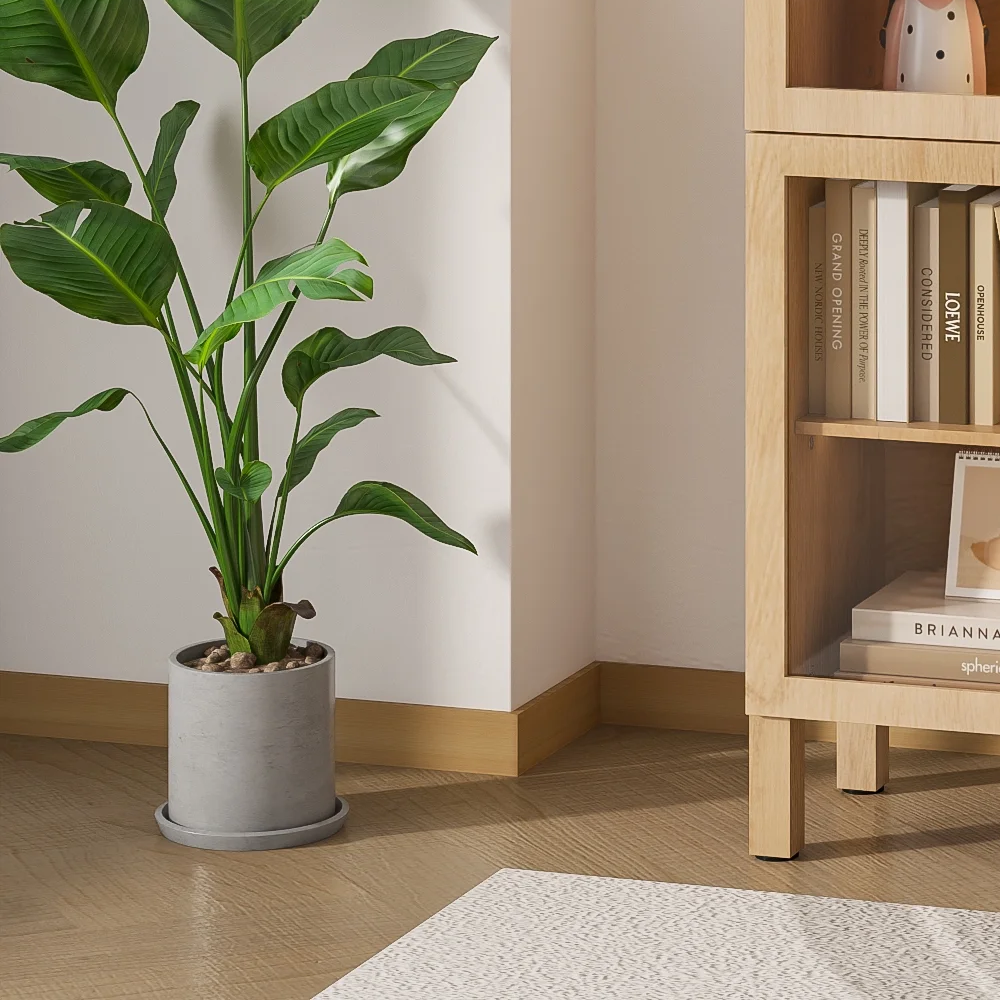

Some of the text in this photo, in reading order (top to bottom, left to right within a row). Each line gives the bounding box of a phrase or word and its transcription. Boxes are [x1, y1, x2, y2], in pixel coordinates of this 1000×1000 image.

[859, 229, 868, 258] DEEPLY
[859, 258, 868, 283] Rooted
[832, 233, 842, 350] GRAND OPENING
[859, 284, 868, 293] IN
[859, 294, 868, 309] THE
[814, 286, 823, 324] NORDIC
[921, 267, 933, 361] CONSIDERED
[944, 292, 961, 342] LOEWE
[976, 285, 985, 341] OPENHOUSE
[859, 311, 868, 339] POWER
[814, 326, 823, 362] HOUSES
[859, 342, 868, 353] OF
